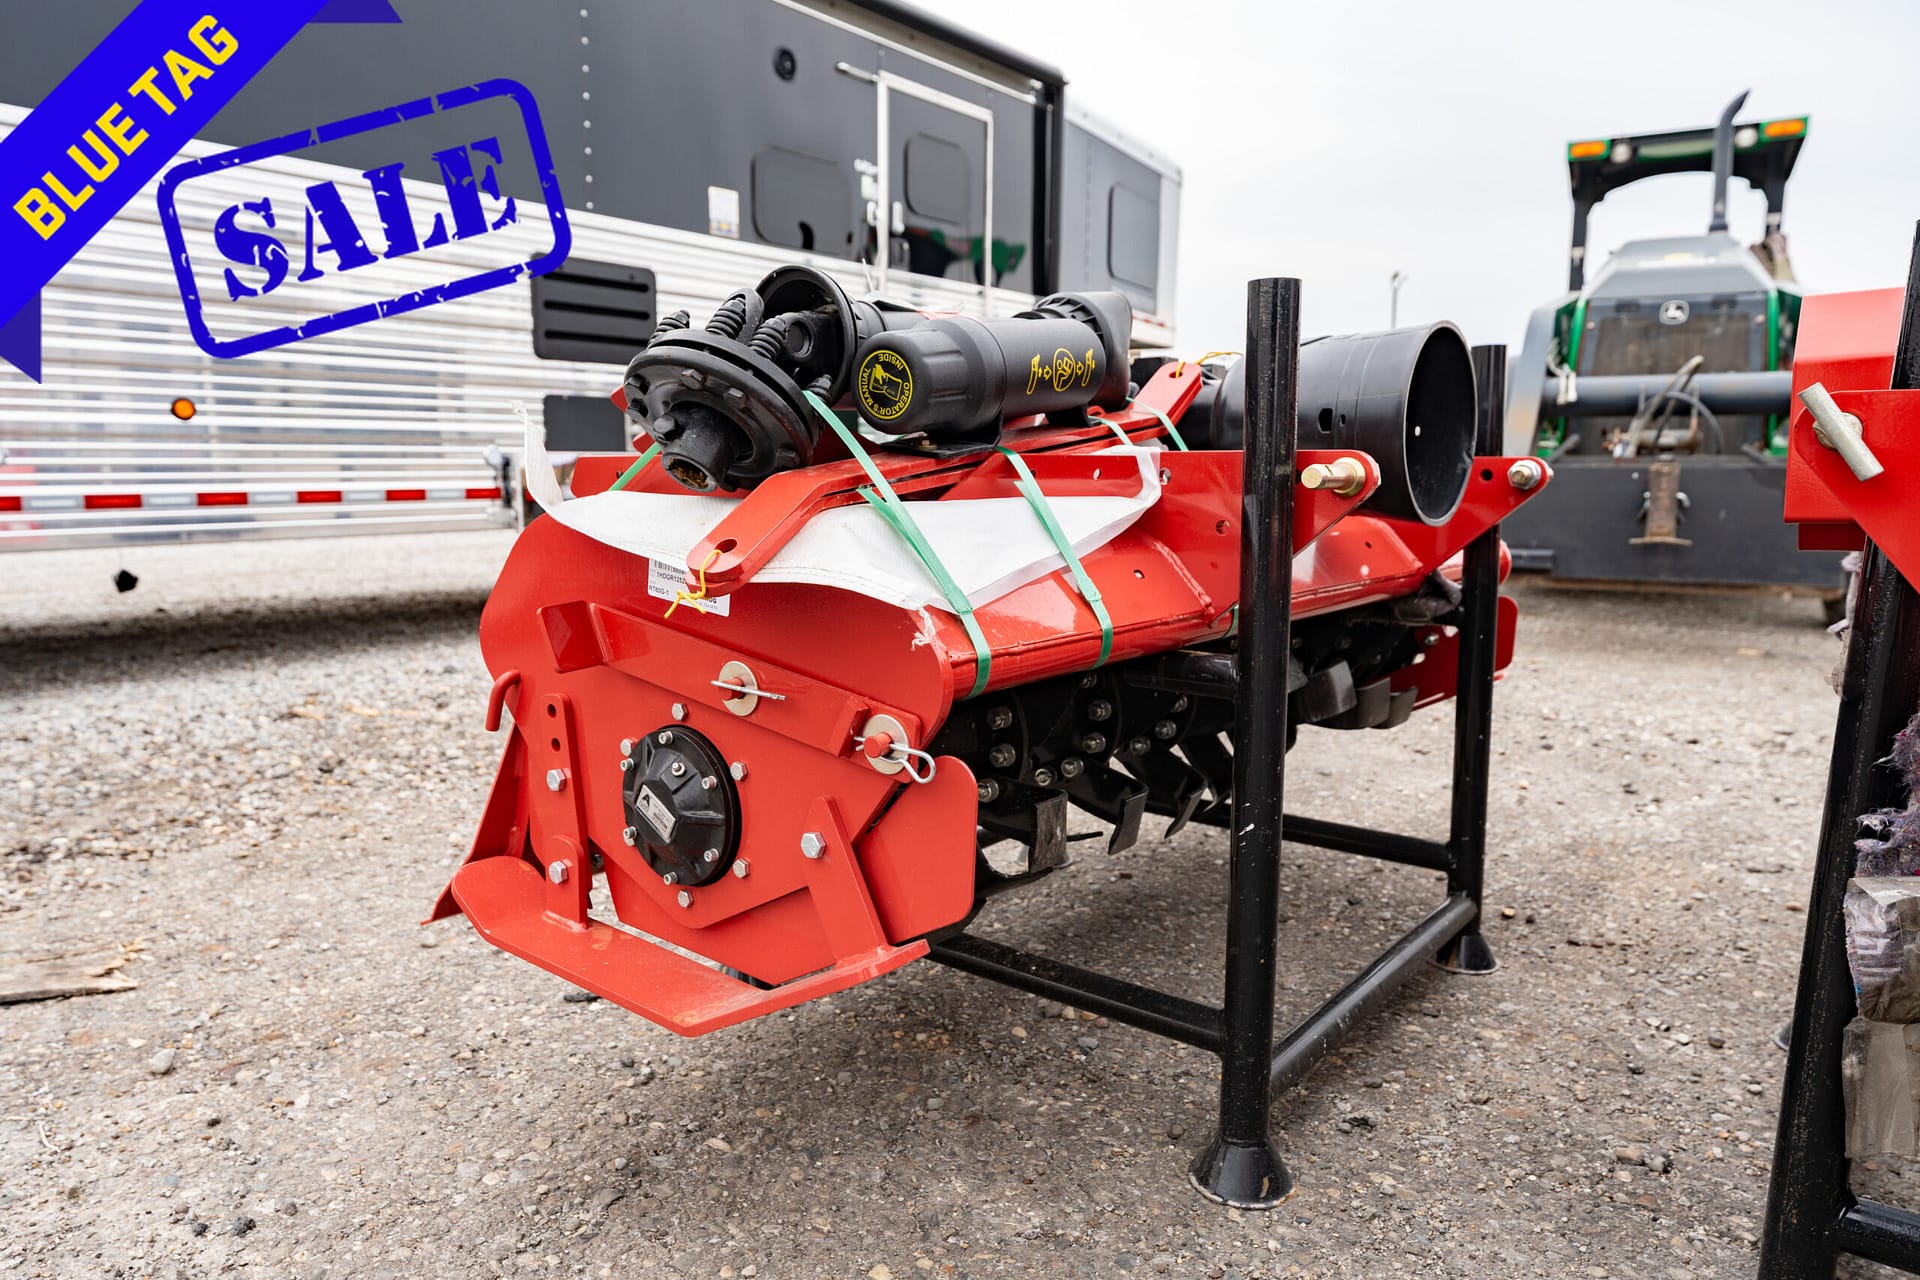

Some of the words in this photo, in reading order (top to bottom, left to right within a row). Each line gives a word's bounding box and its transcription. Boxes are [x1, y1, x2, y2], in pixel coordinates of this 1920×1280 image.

[878, 353, 904, 370] INSIDE
[861, 367, 874, 406] MANUAL
[873, 382, 910, 415] OPERATOR'S
